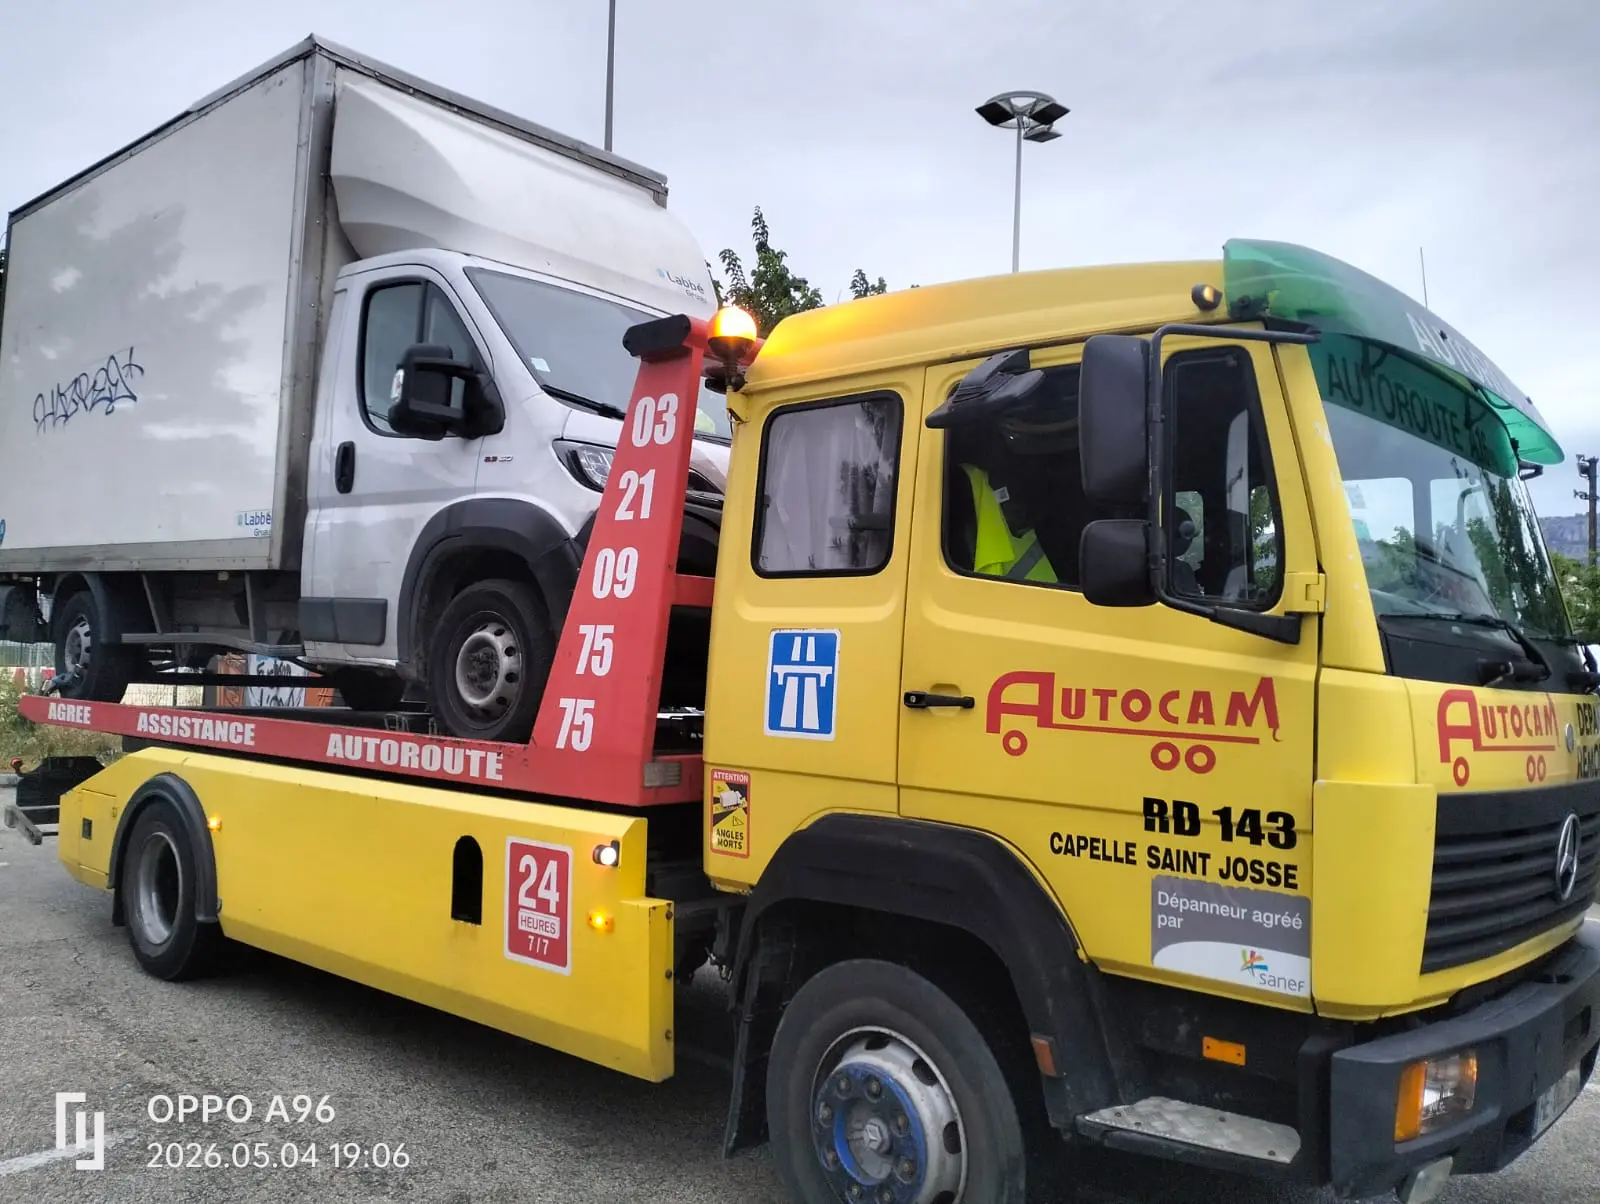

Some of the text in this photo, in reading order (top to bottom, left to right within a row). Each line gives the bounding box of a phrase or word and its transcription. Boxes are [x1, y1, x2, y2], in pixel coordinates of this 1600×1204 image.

[632, 393, 678, 447] 03
[615, 469, 656, 520] 21
[592, 547, 639, 599] 09
[576, 625, 614, 676] 75
[48, 702, 92, 725] AGREE
[137, 712, 256, 746] ASSISTANCE
[556, 698, 595, 752] 75
[326, 733, 504, 781] AUTOROUTE
[713, 771, 748, 782] ATTENTION
[716, 828, 744, 841] ANGLES
[717, 838, 743, 850] MORTS
[1143, 797, 1297, 850] RD 143
[518, 854, 560, 914] 24
[1050, 832, 1299, 890] CAPELLE SAINT JOSSE
[520, 915, 557, 935] HEURES
[1157, 891, 1302, 930] Dépanneur agréé
[1157, 914, 1183, 928] par
